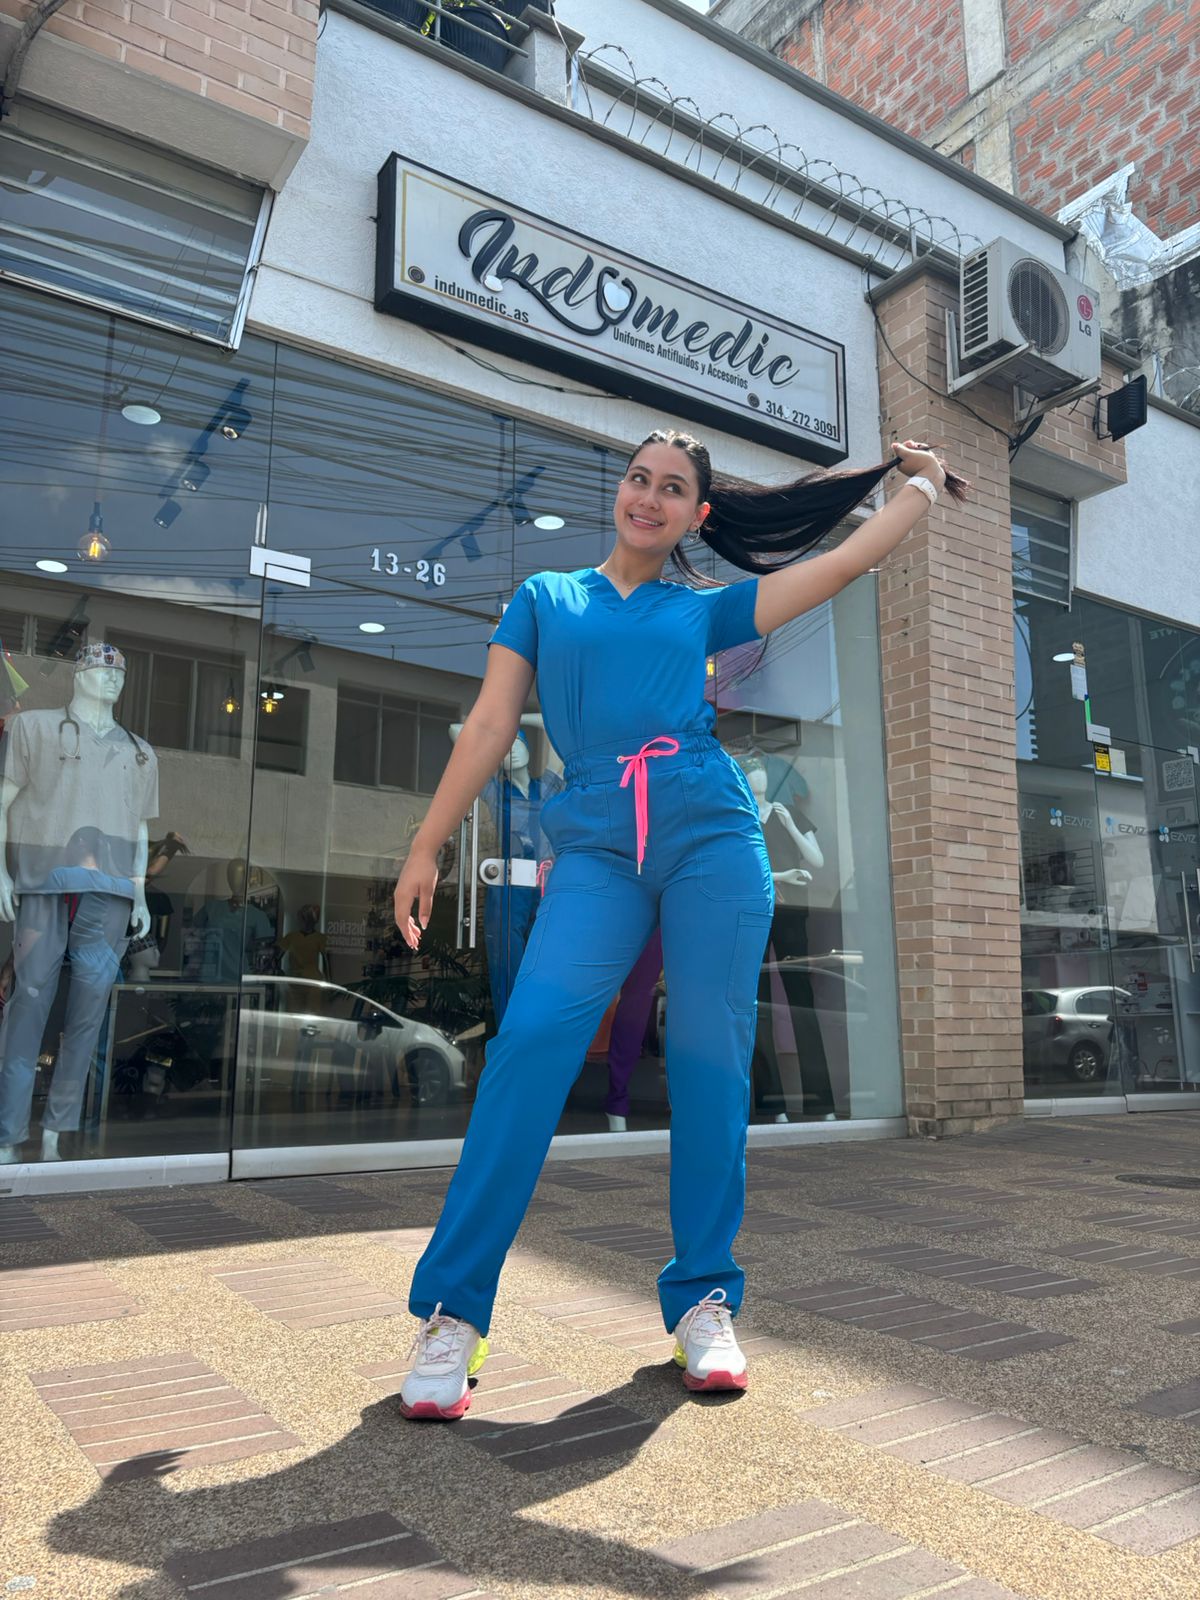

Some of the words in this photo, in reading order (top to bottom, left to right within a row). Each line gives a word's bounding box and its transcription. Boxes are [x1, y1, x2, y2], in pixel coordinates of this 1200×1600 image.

[434, 275, 529, 323] indumedic_as
[1079, 320, 1092, 337] LG
[613, 327, 655, 354] Uniformes
[657, 343, 699, 371] Antifluidos
[700, 363, 706, 375] y
[708, 363, 748, 390] Accesorios
[766, 400, 784, 418] 314
[792, 410, 810, 428] 272
[814, 419, 836, 438] 3091
[371, 548, 446, 586] 13-26
[1063, 815, 1093, 828] EZVIZ
[1118, 823, 1147, 836] EZVIZ
[1170, 832, 1197, 844] EZVIZ
